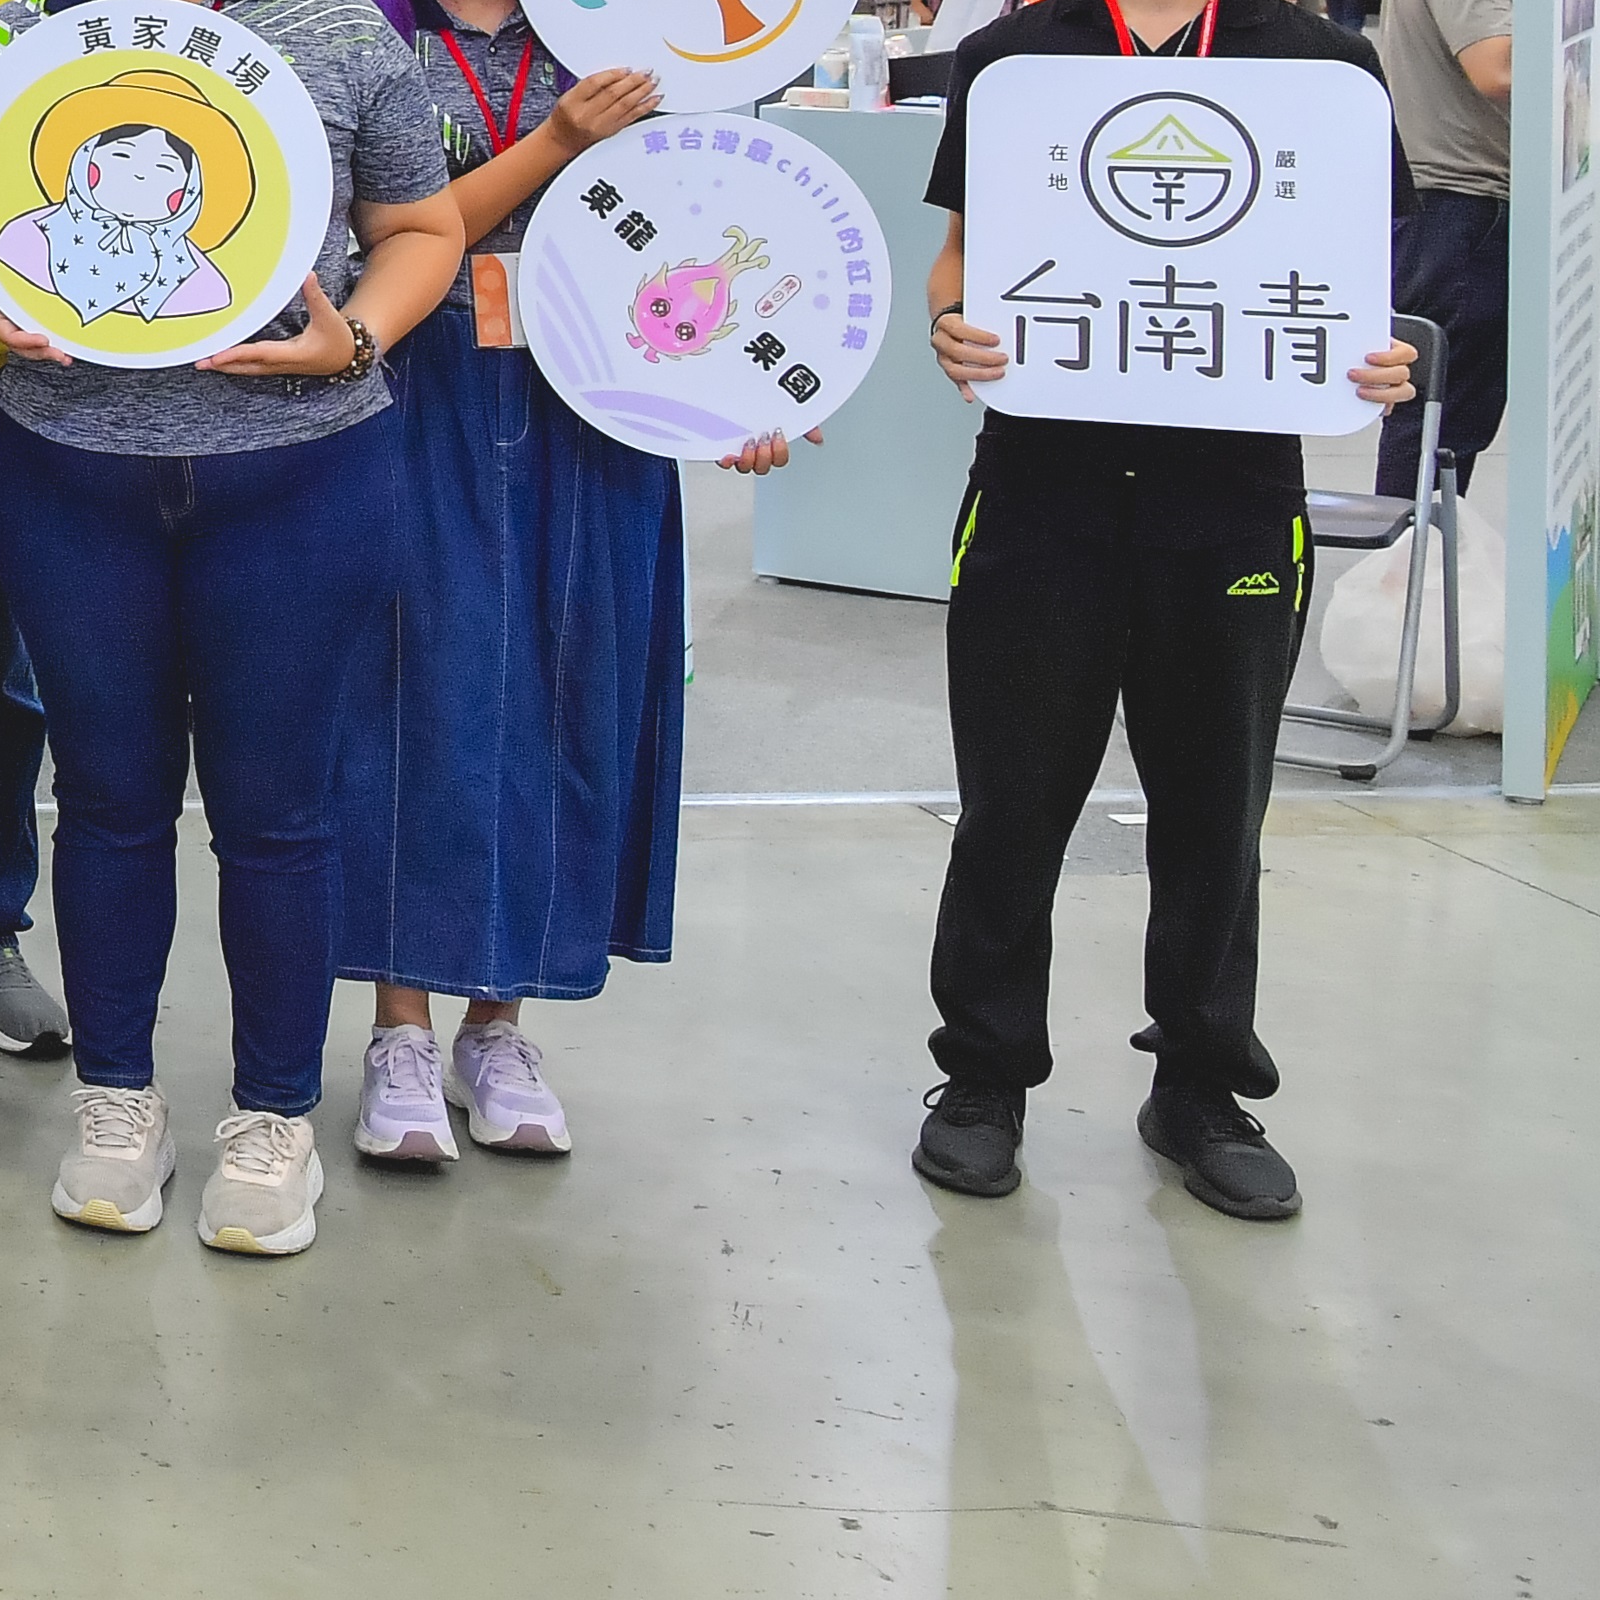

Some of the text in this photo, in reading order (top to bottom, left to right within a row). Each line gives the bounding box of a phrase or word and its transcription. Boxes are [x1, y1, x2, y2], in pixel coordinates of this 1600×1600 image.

[77, 15, 271, 95] 黃家農場
[1047, 143, 1069, 192] 在地
[1274, 149, 1297, 200] 嚴選
[1000, 259, 1350, 386] 台南青
